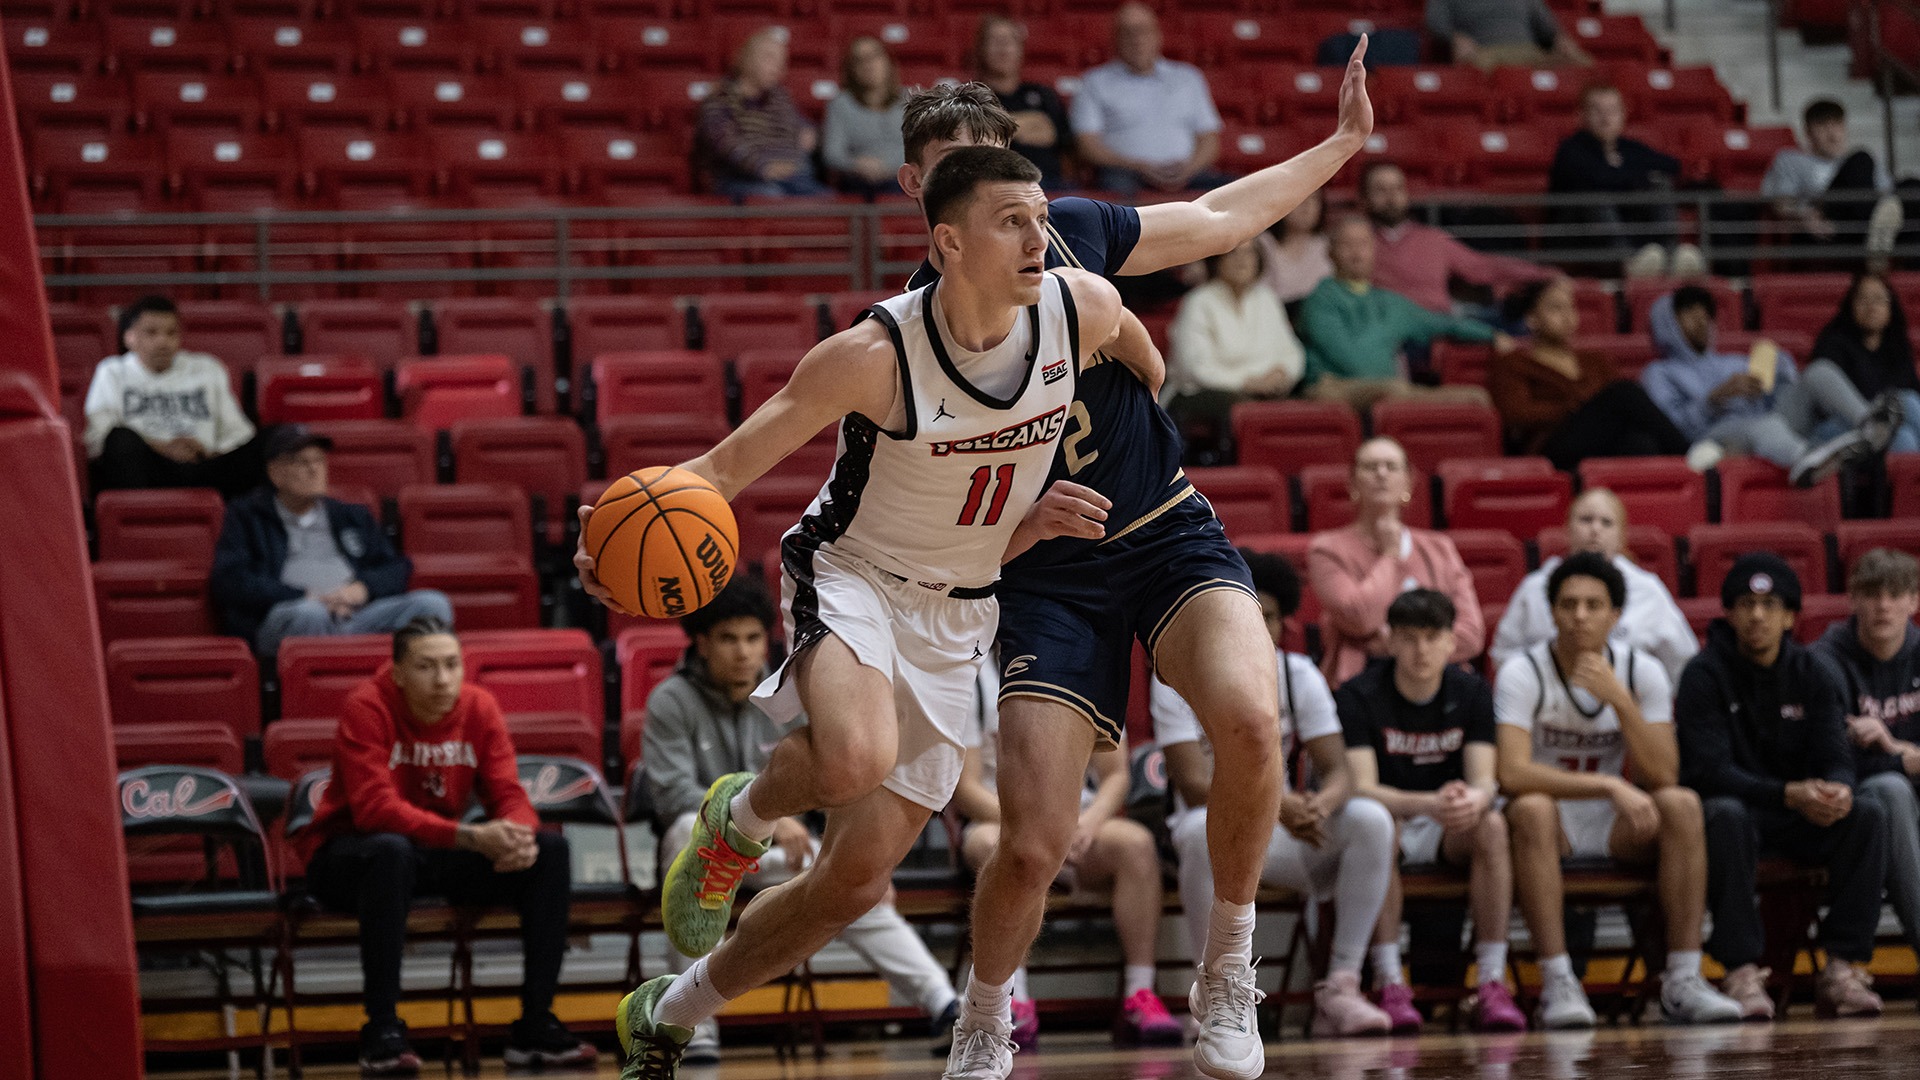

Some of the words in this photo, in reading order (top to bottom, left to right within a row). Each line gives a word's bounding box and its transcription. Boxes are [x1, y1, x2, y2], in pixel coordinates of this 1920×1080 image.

[1042, 362, 1067, 380] PSAC
[956, 463, 1016, 526] 11
[121, 775, 230, 818] Cal
